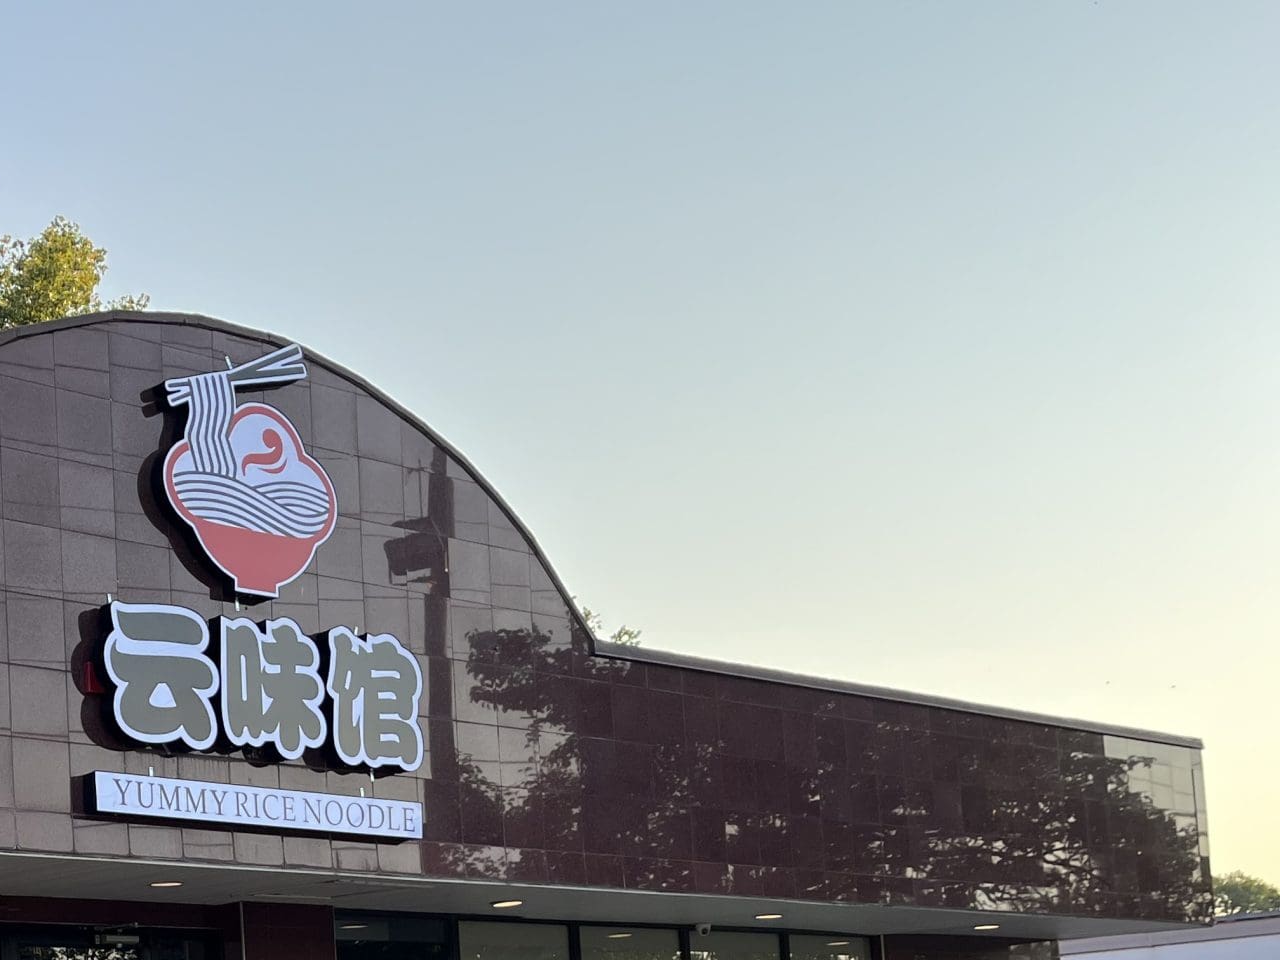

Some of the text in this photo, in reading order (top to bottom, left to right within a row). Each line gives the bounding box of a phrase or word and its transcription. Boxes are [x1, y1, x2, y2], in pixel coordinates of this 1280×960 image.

[105, 602, 424, 771] 云味馆
[112, 778, 416, 833] YUMMY RICE NOODLE
